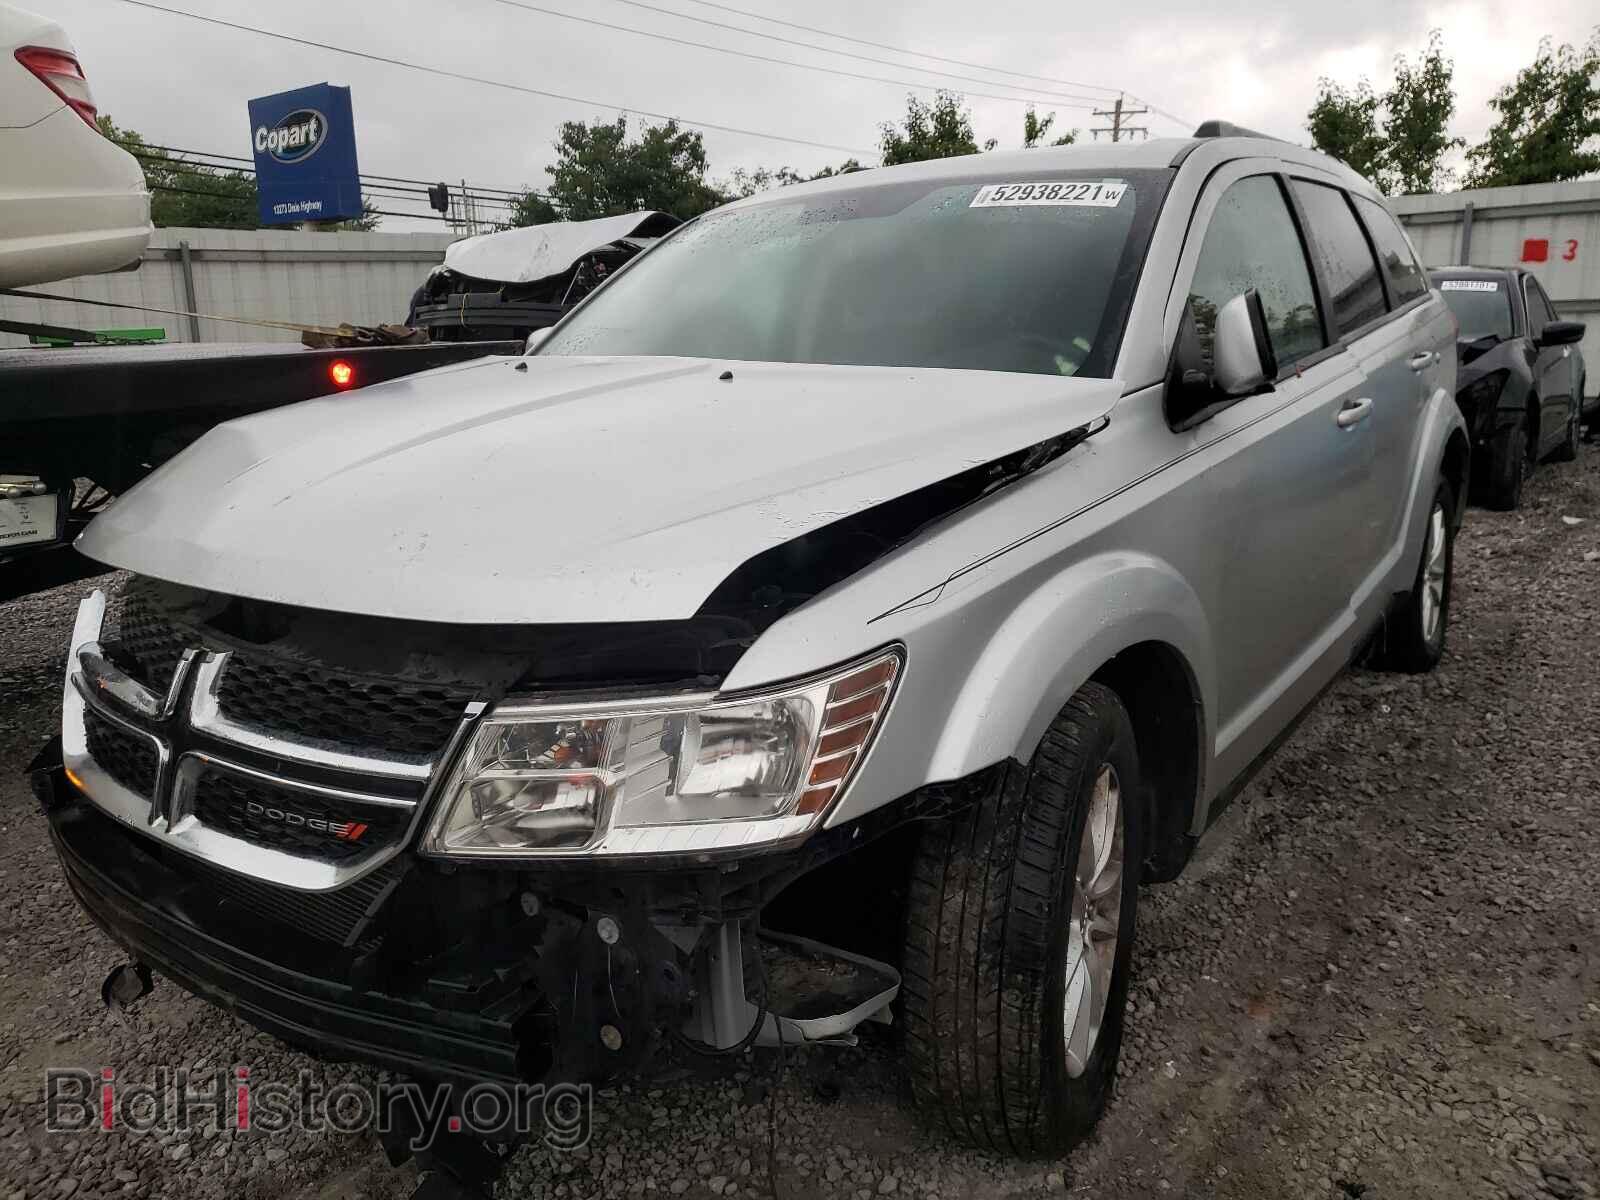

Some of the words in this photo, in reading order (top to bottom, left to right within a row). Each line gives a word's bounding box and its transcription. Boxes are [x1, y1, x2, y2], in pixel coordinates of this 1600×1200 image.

[255, 117, 319, 152] Copart
[991, 184, 1103, 202] 52938221
[1562, 238, 1579, 261] 3
[246, 801, 350, 836] DODGE
